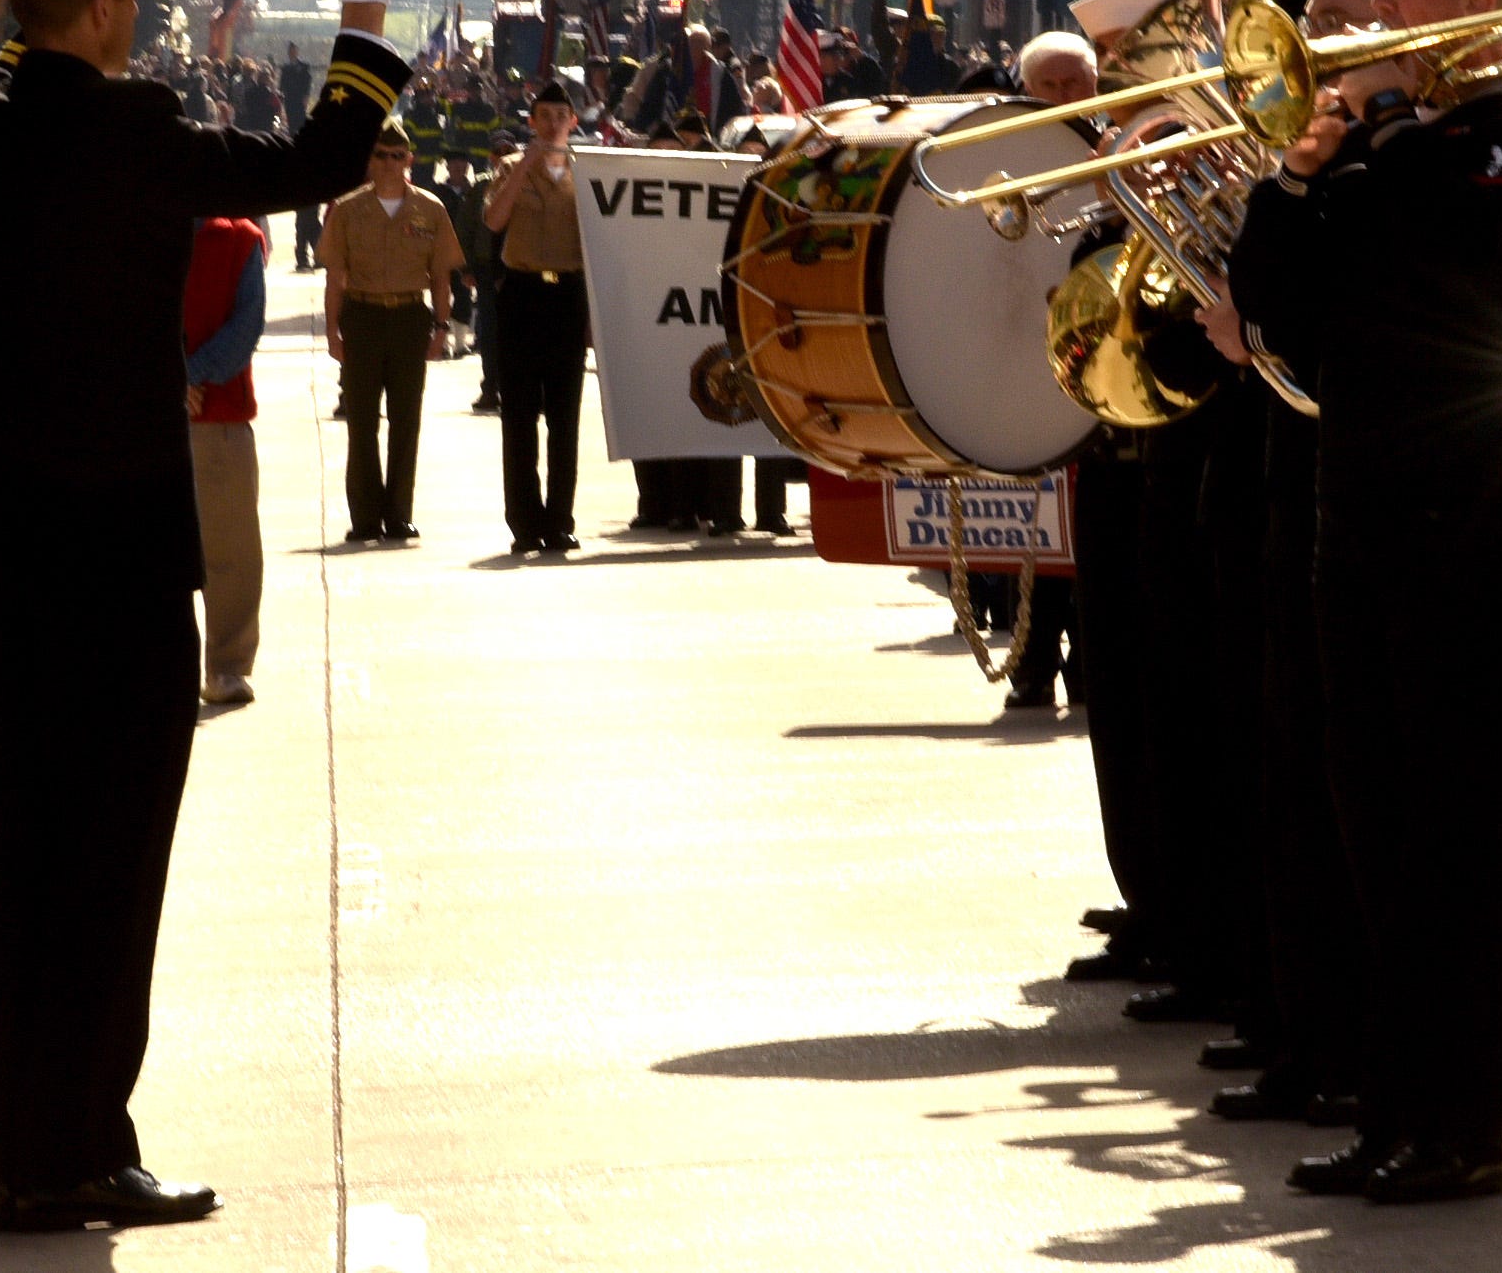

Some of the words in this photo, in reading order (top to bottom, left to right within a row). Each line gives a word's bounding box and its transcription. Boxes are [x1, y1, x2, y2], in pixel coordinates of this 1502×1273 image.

[589, 178, 740, 220] VETE
[914, 489, 1037, 524] Jimmy
[907, 519, 1051, 547] Duncan
